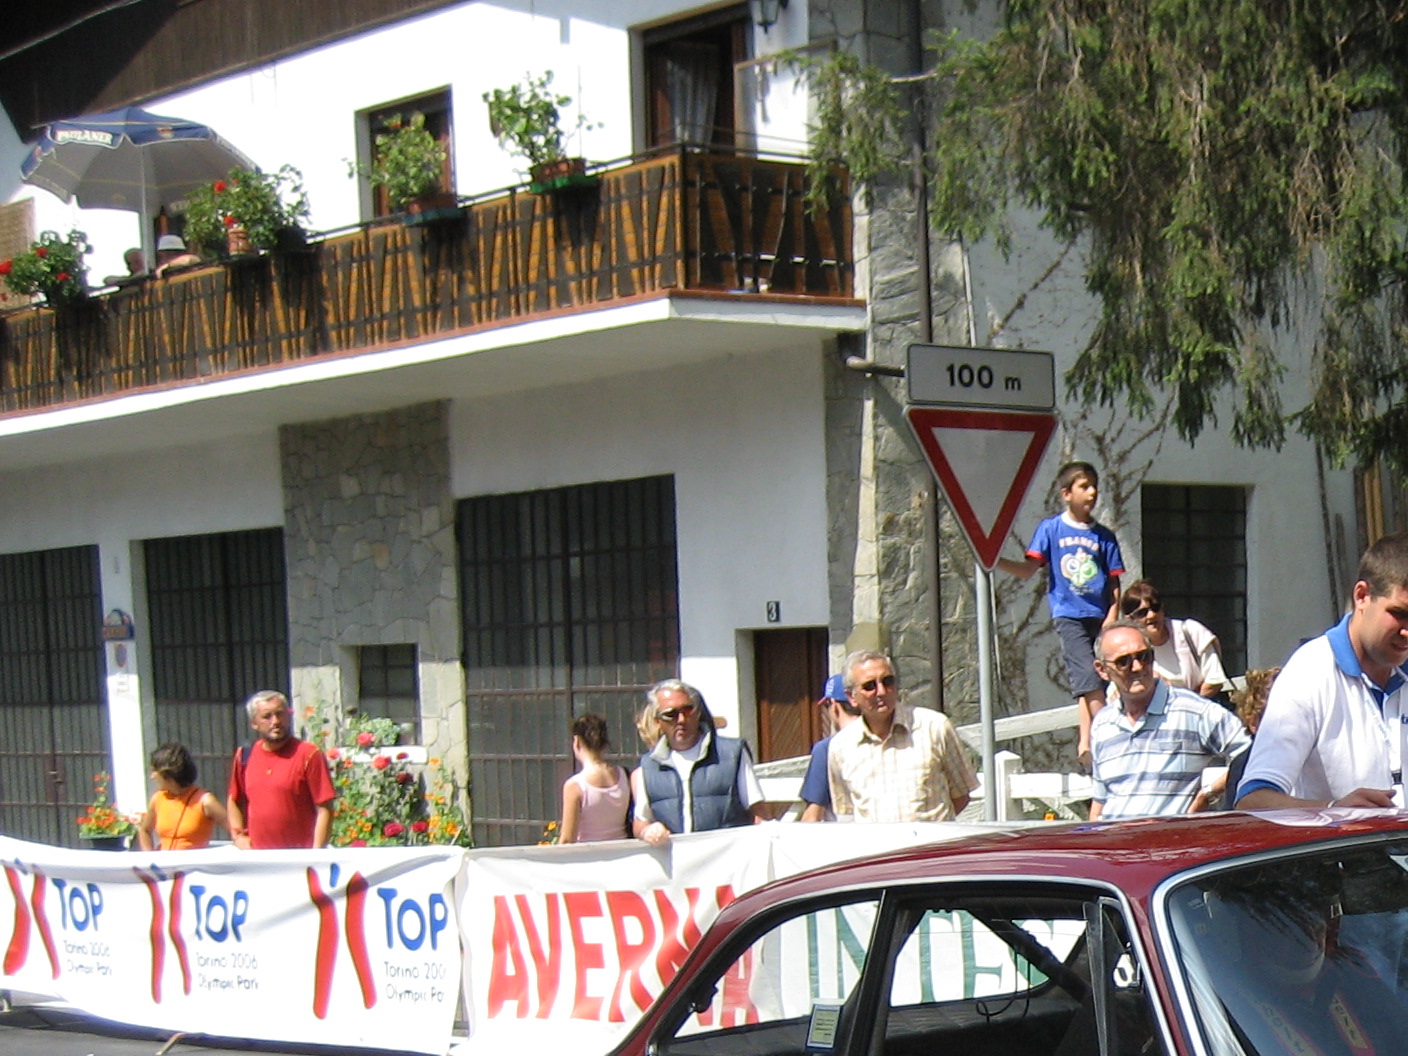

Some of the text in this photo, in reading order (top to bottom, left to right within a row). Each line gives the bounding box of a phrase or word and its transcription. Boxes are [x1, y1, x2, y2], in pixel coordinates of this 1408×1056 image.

[946, 363, 1022, 391] 100 m
[769, 601, 777, 620] 3
[51, 877, 104, 932] TOP
[189, 885, 249, 943] TOP
[376, 887, 449, 951] TOP
[196, 952, 259, 969] Torino 2006
[384, 961, 420, 979] Torino
[487, 884, 759, 1028] AVERNA
[385, 983, 428, 1005] Olympic
